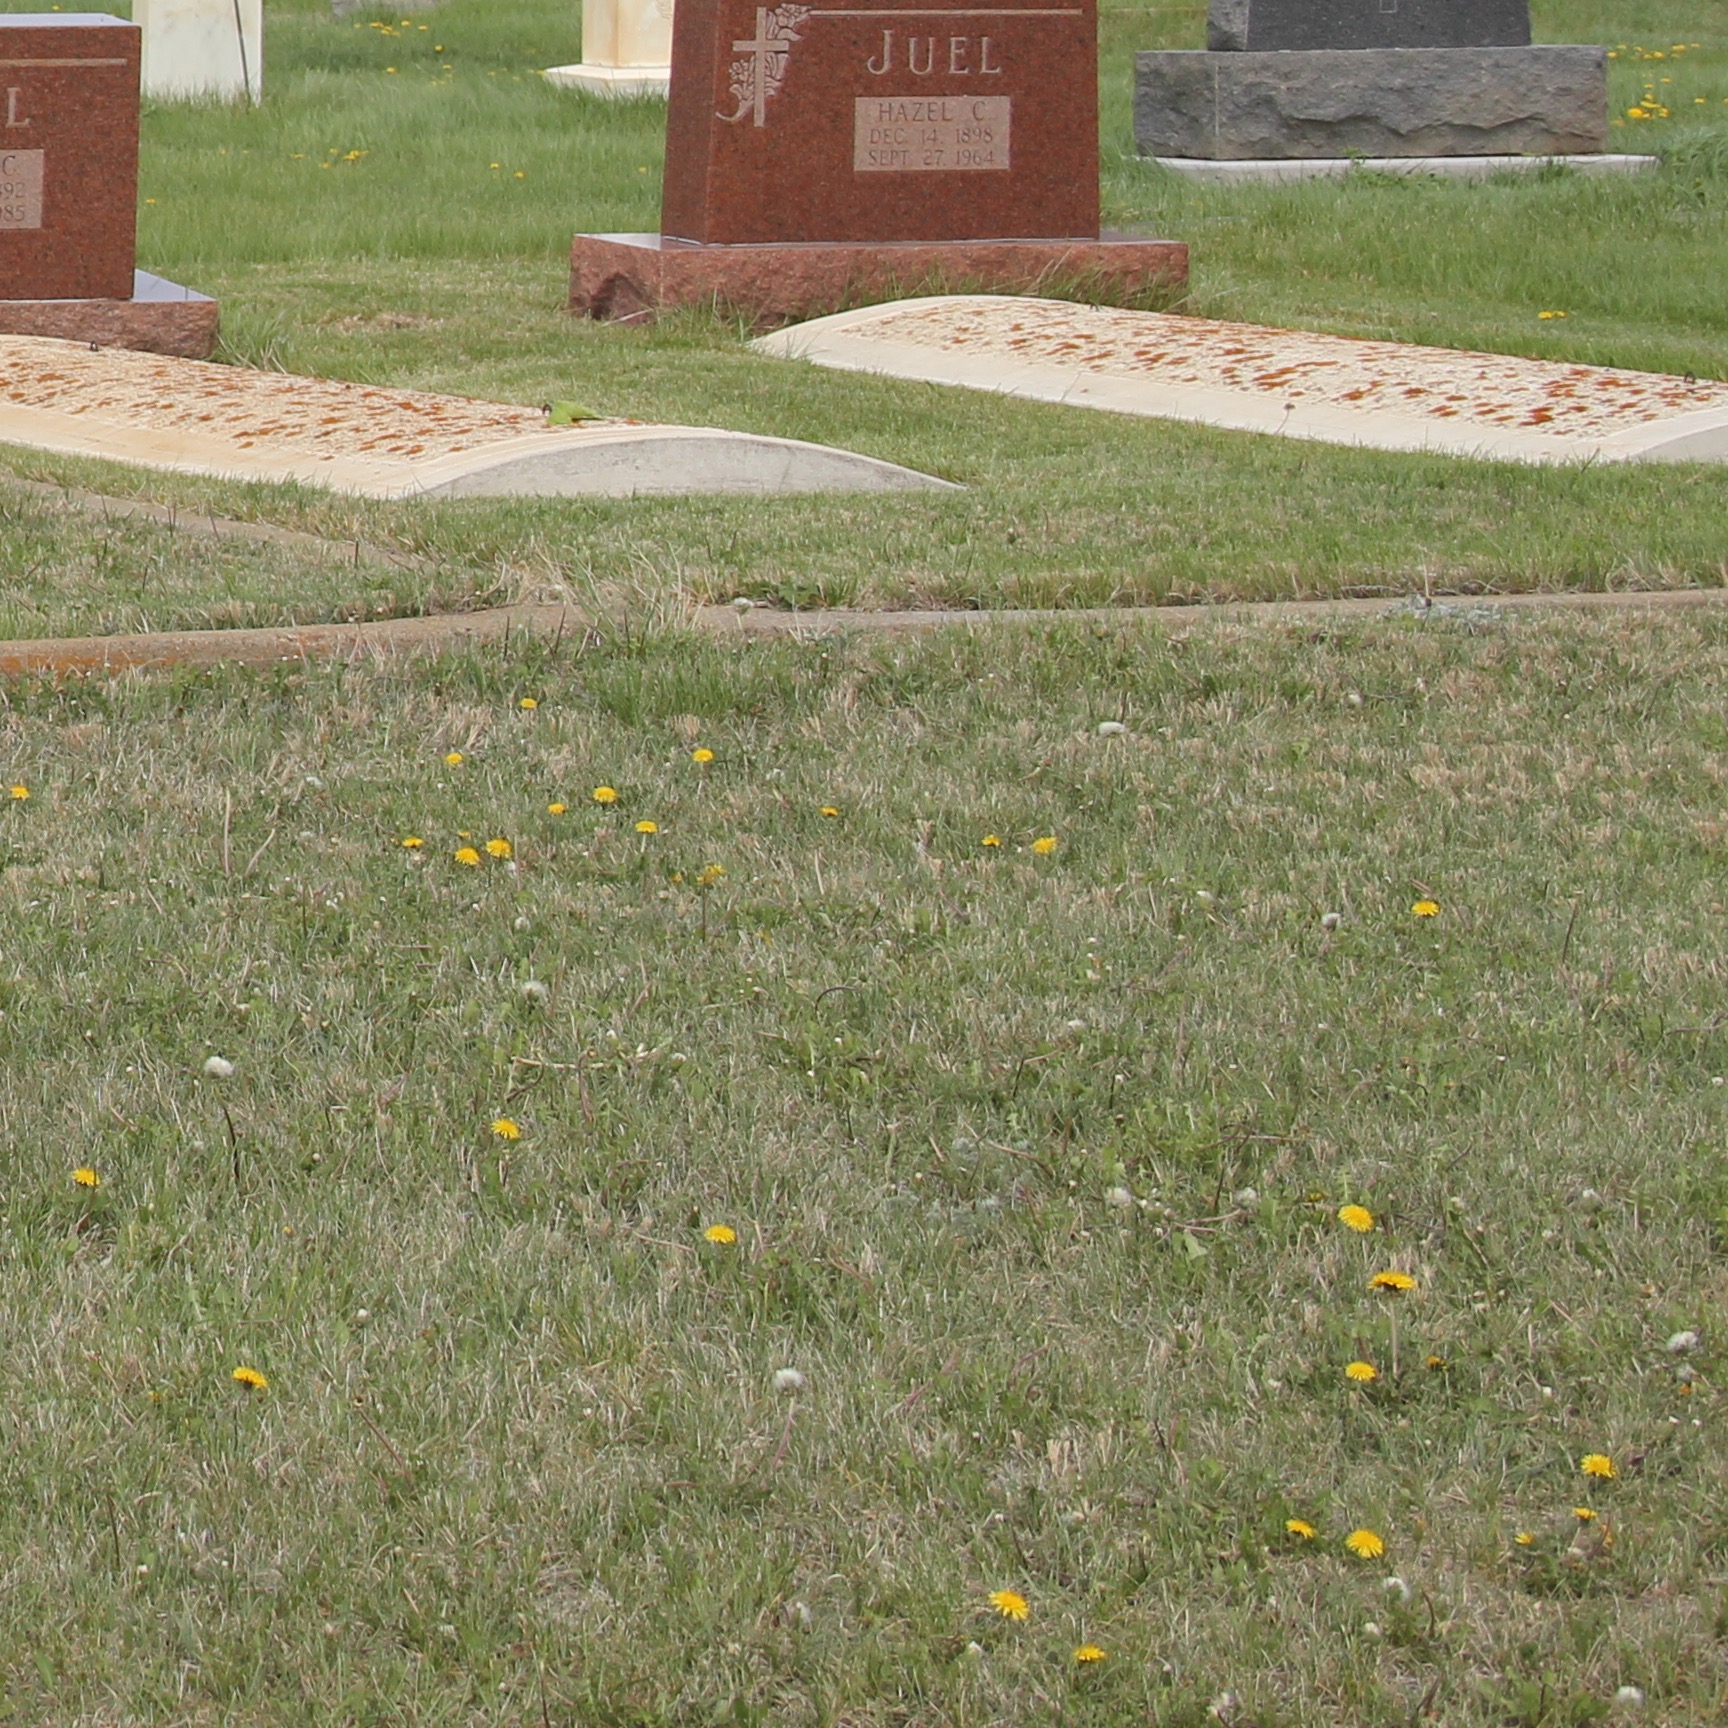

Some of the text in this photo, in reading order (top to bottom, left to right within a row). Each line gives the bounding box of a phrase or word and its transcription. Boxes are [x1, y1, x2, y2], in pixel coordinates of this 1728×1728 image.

[866, 29, 1001, 75] JUEL
[878, 102, 953, 122] HAZEL
[955, 127, 994, 144] 1898
[955, 149, 995, 166] 1964
